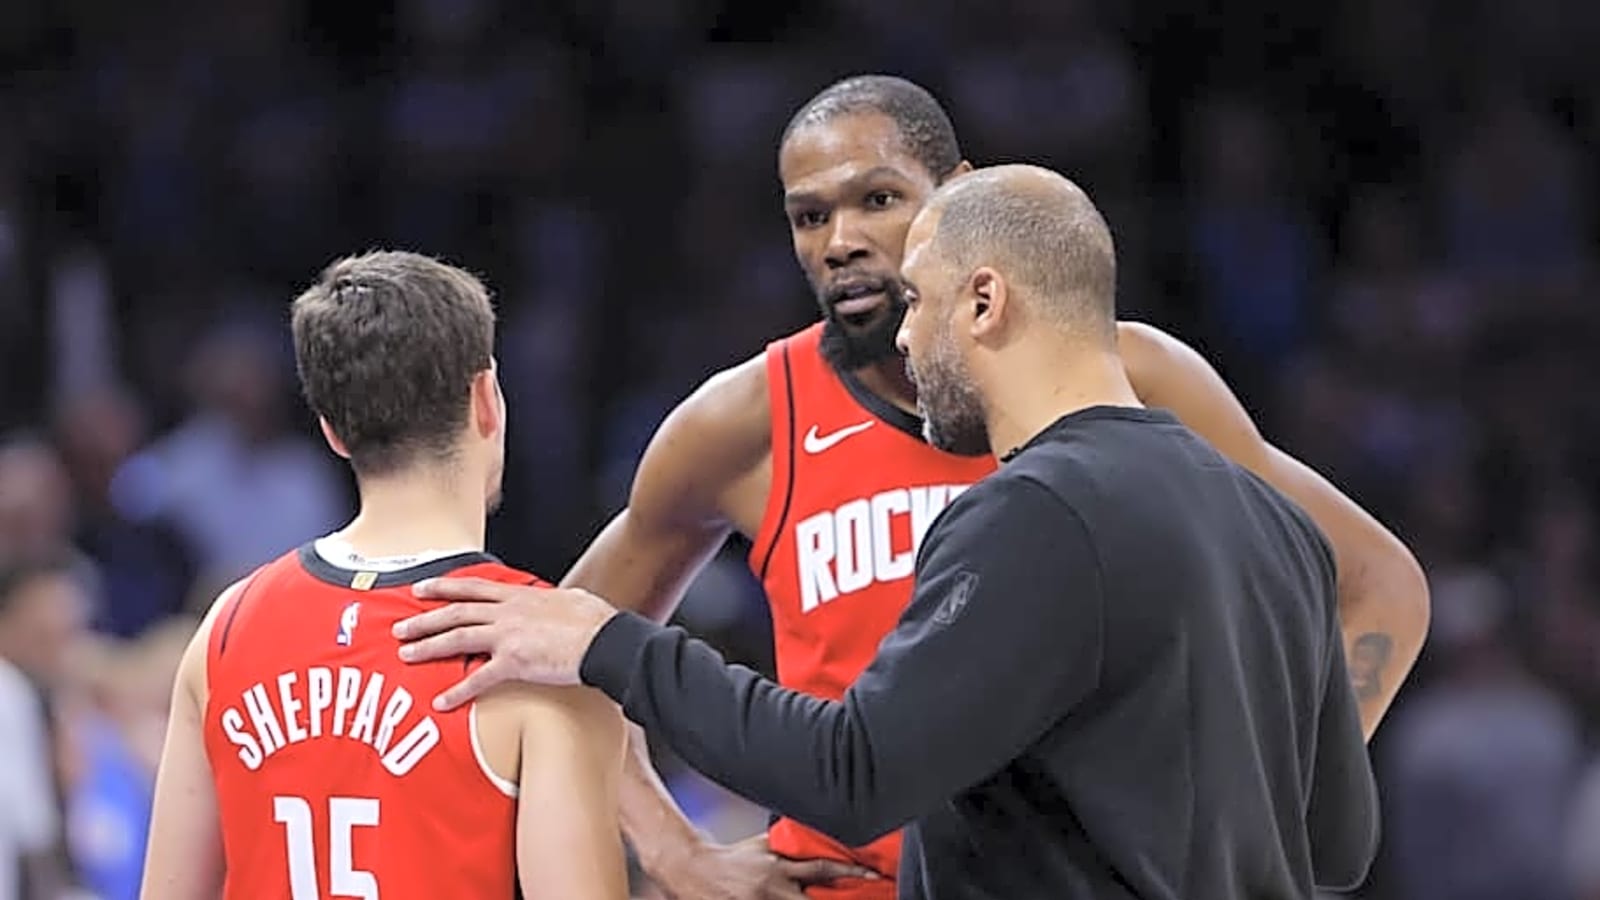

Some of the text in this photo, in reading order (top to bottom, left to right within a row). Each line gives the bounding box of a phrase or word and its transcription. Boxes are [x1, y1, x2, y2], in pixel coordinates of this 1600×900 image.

[796, 484, 974, 613] ROCK
[222, 667, 441, 776] SHEPPARD
[273, 796, 380, 900] 15
